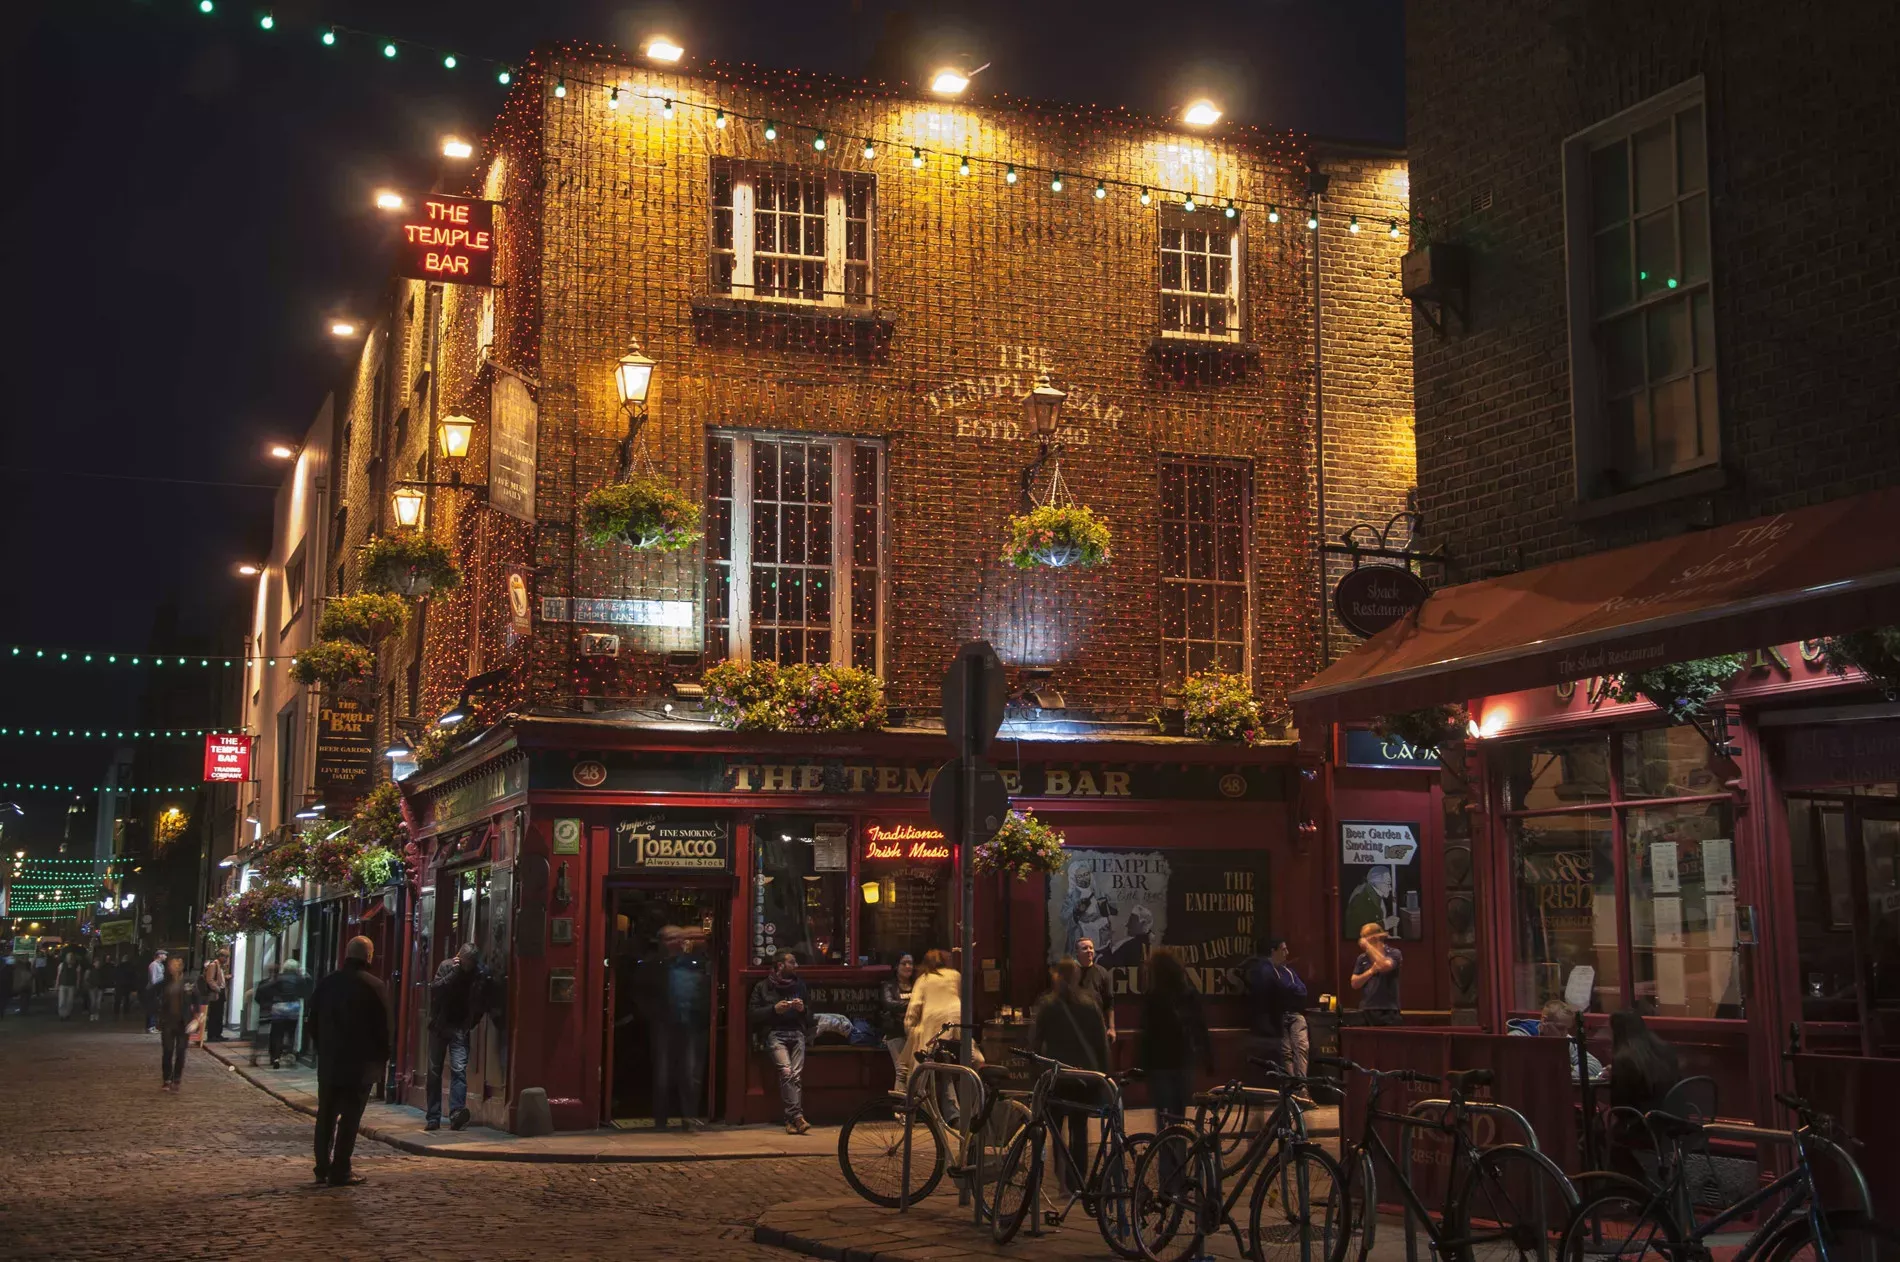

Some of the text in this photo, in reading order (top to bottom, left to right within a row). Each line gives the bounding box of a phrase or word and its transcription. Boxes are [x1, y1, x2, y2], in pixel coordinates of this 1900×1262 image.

[426, 202, 469, 223] THE
[404, 225, 490, 250] TEMPLE
[425, 253, 469, 274] BAR
[610, 613, 635, 621] LANE
[220, 737, 239, 745] THE
[210, 745, 247, 754] TEMPLE
[217, 754, 238, 762] BAR
[341, 767, 367, 775] MUSIC
[579, 765, 600, 780] 48
[728, 765, 825, 792] THE
[1044, 770, 1131, 795] BAR
[1223, 779, 1240, 792] 48
[659, 829, 717, 838] FINE SMOKING
[1345, 828, 1411, 840] Beer Garden &
[866, 842, 950, 859] Irish Music
[1345, 840, 1384, 853] Smoking
[646, 858, 680, 867] Always
[697, 858, 723, 867] Stock
[1353, 852, 1375, 863] Area
[1088, 858, 1166, 874] TEMPLE
[1112, 874, 1149, 891] BAR
[1224, 871, 1255, 891] THE
[1185, 893, 1254, 913] EMPEROR
[1237, 915, 1255, 935] OF
